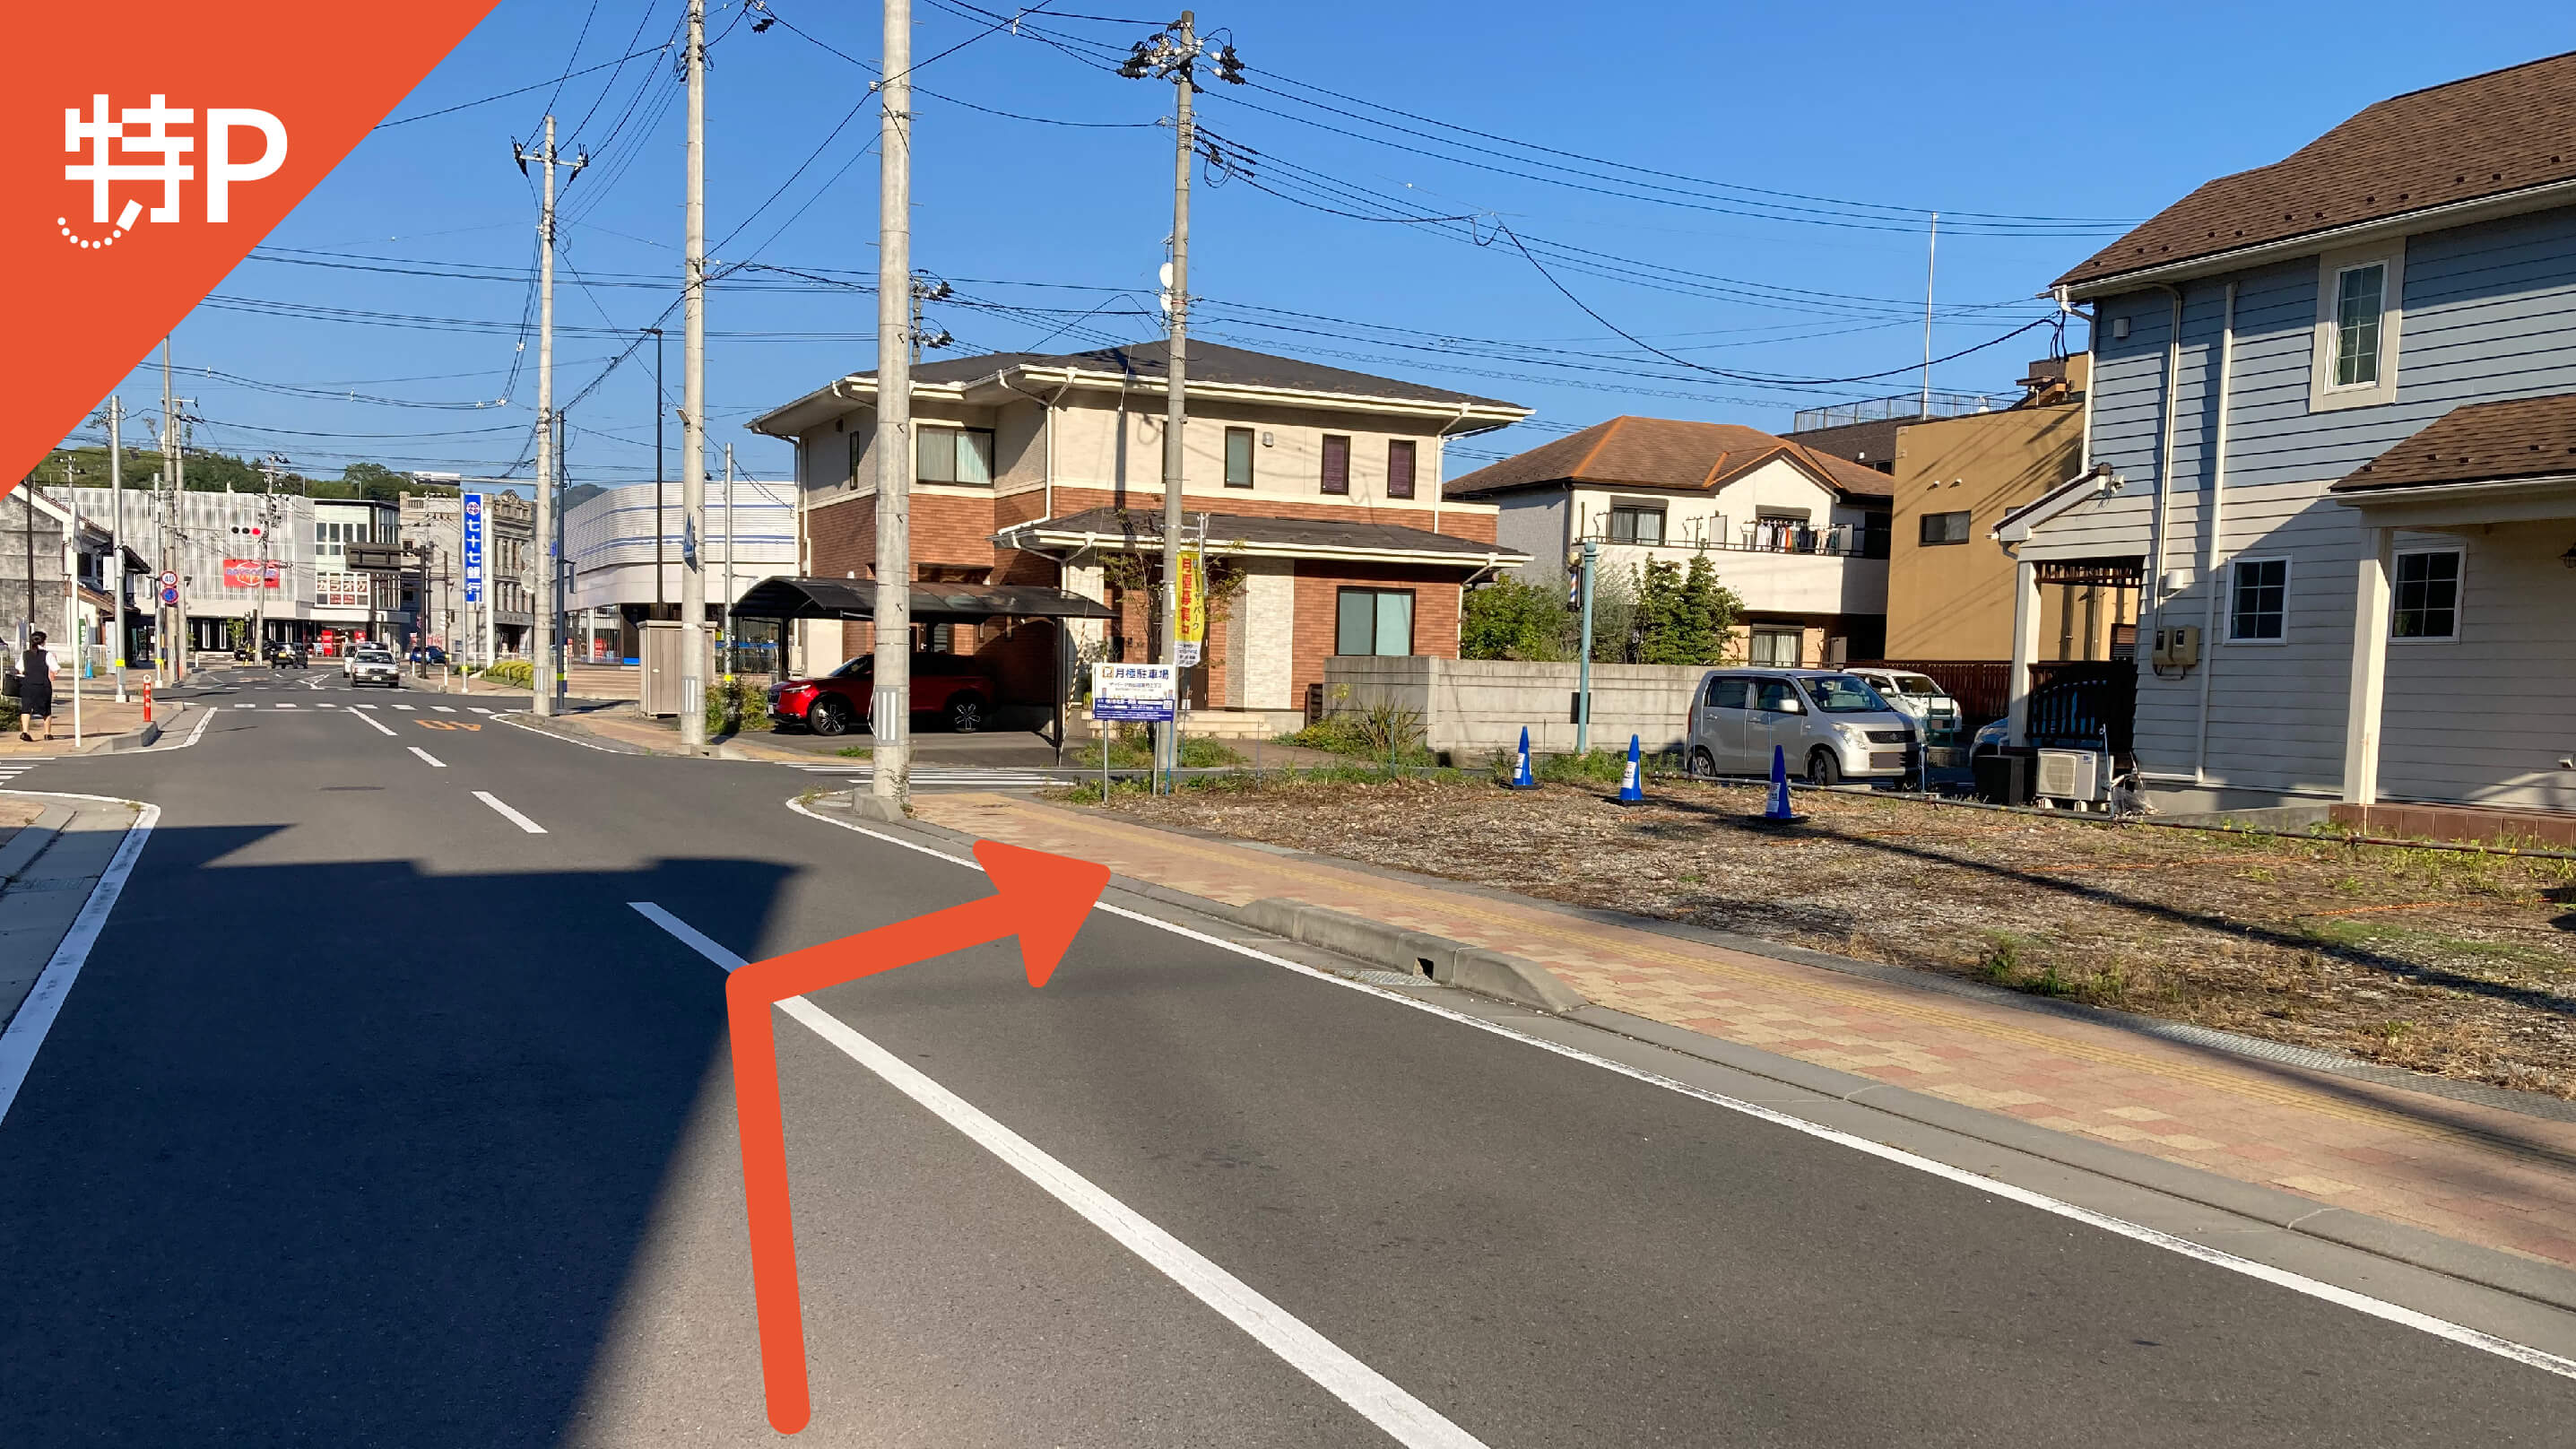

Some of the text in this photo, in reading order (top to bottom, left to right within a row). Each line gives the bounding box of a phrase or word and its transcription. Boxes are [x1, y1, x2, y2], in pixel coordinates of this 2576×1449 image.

[466, 518, 481, 597] 七十七銀行
[164, 575, 175, 583] 40
[1115, 668, 1169, 680] 月極駐車場
